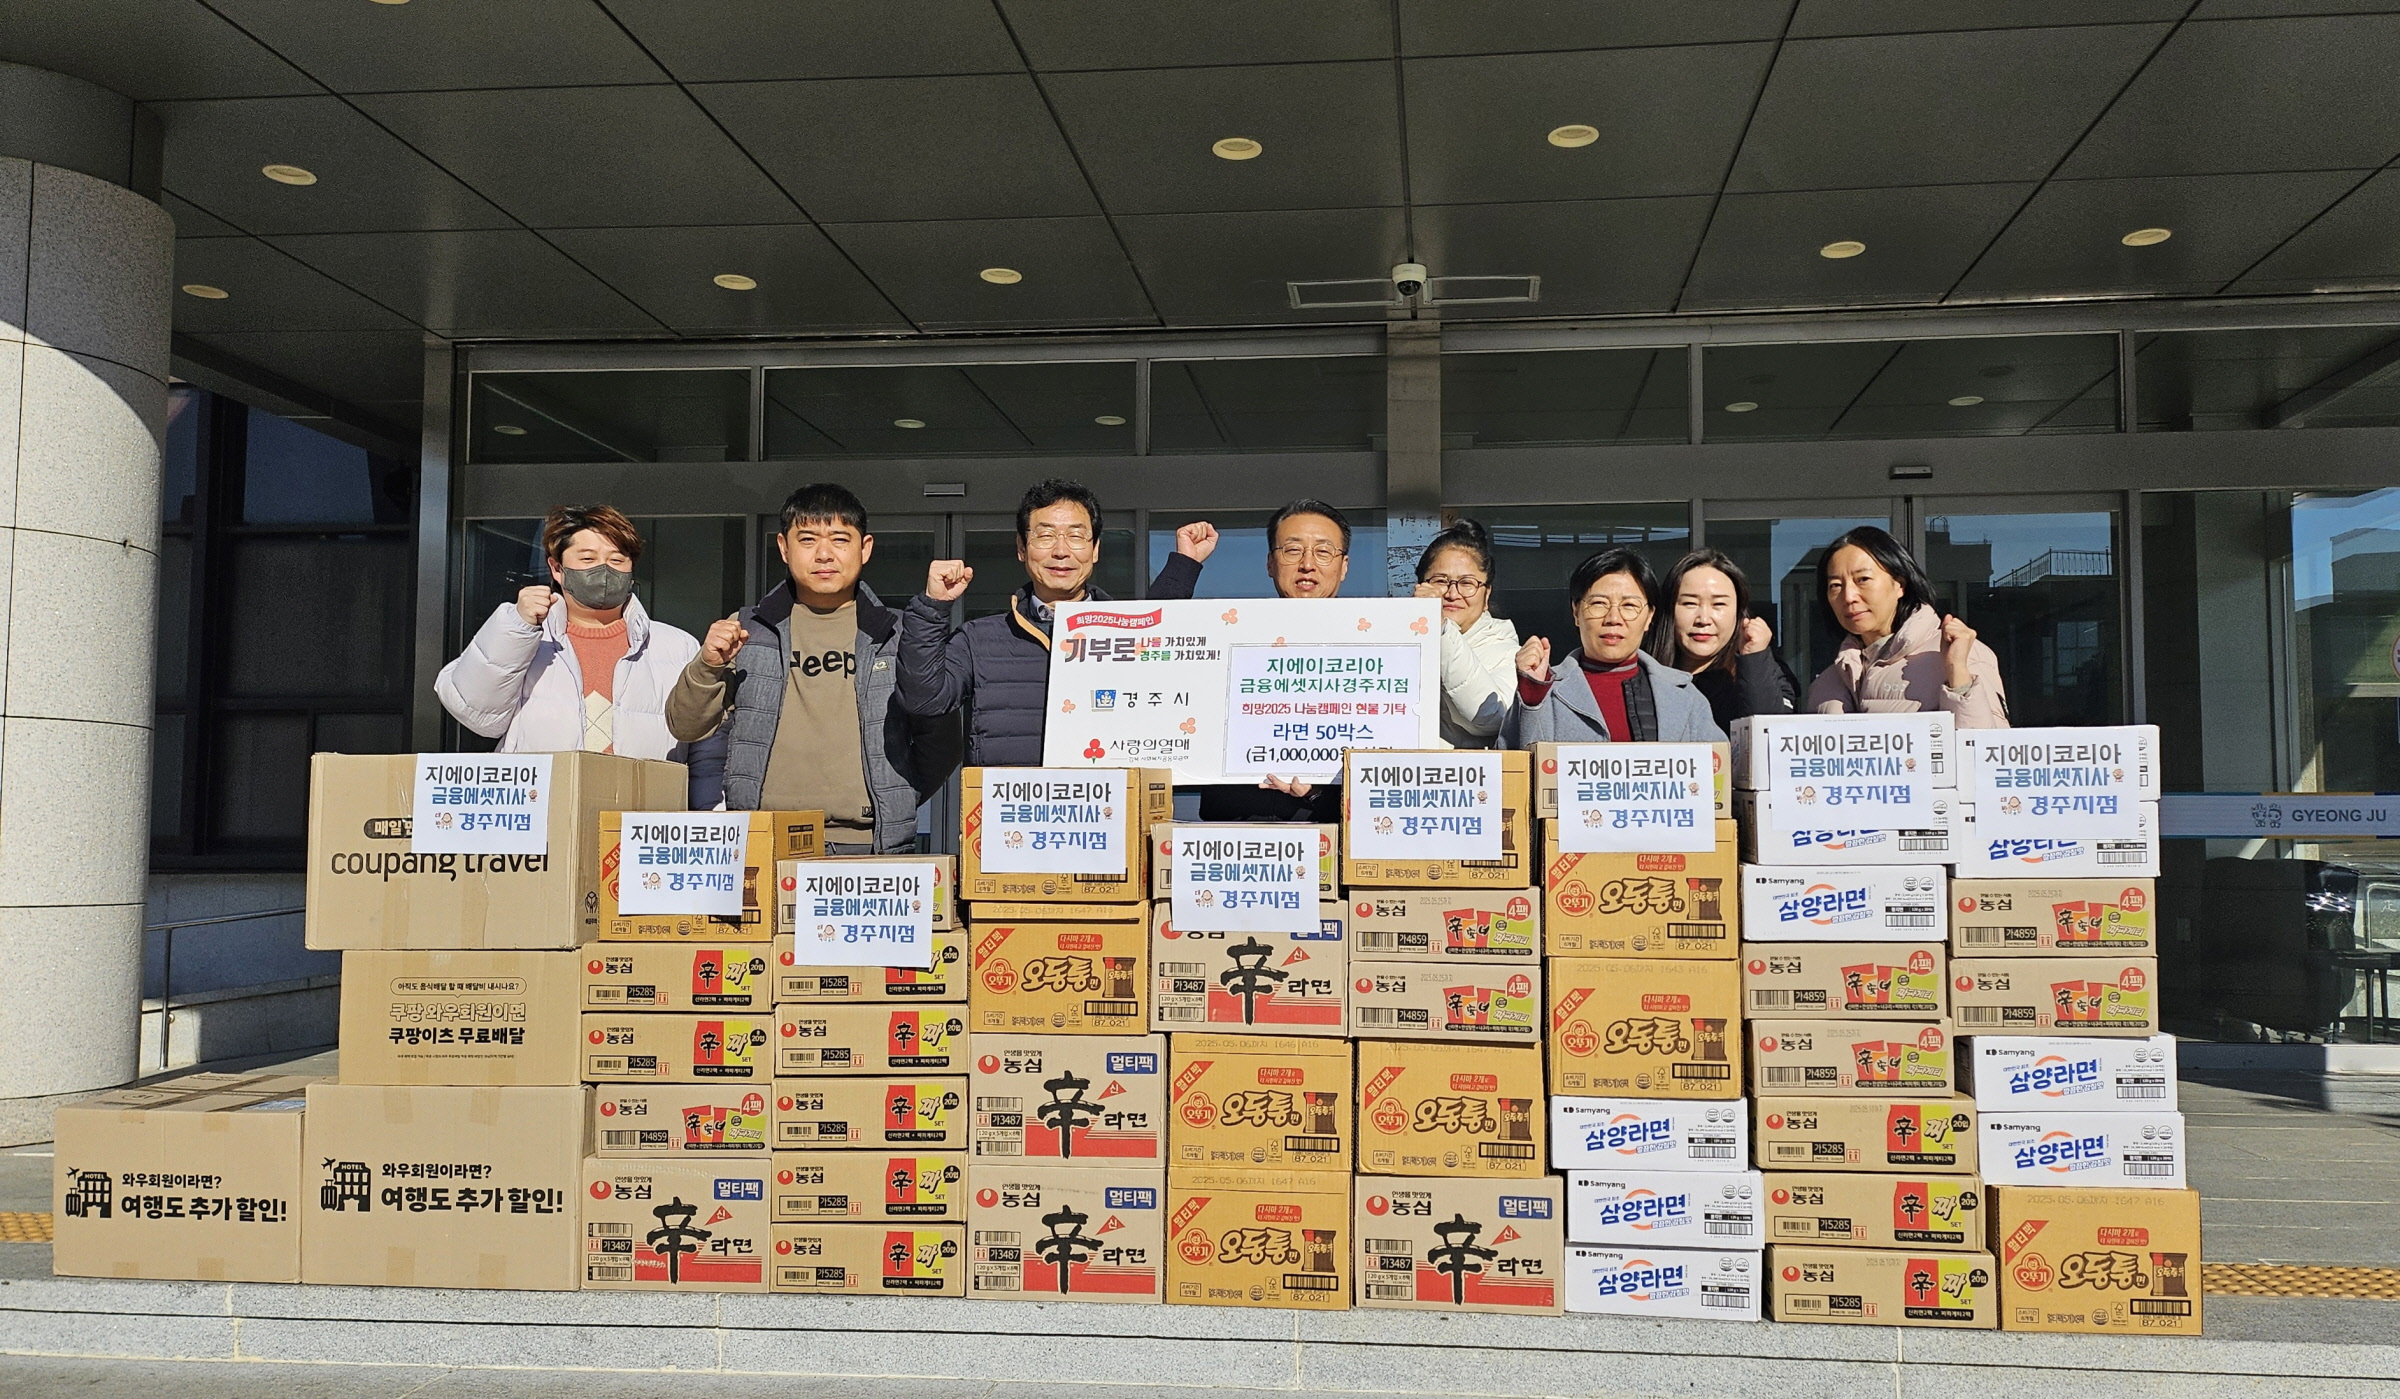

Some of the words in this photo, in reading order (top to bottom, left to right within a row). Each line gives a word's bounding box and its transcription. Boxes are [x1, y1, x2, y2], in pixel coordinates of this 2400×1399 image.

[1076, 615, 1154, 628] 희망2025나눔캠페인
[1141, 637, 1161, 647] 나를
[1165, 637, 1206, 647] 가치있게
[1065, 638, 1135, 662] 기부로
[1140, 651, 1171, 661] 경주를
[1174, 650, 1220, 661] 가치있게!
[1267, 657, 1383, 674] 지에이코리아
[1240, 678, 1408, 693] 금융에셋지사경주지점
[1242, 703, 1291, 715] 희망2025
[1295, 703, 1352, 715] 나눔캠페인
[1356, 703, 1379, 715] 현물
[1383, 703, 1406, 715] 기탁
[1273, 723, 1309, 741] 라면
[1316, 723, 1374, 741] 50박스
[1110, 738, 1190, 755] 사랑의열매
[1780, 734, 1913, 755] 지에이코리아
[1985, 744, 2121, 766] 지에이코리아
[425, 765, 537, 785] 지에이코리아
[1568, 759, 1696, 779] 지에이코리아
[1790, 757, 1902, 778] 금융에셋지사
[1360, 767, 1486, 786] 지에이코리아
[1995, 767, 2109, 788] 금융에셋지사
[432, 787, 526, 806] 금융에셋지사
[992, 782, 1111, 802] 지에이코리아
[1369, 789, 1474, 808] 금융에셋지사
[1577, 781, 1686, 801] 금융에셋지사
[1823, 785, 1910, 805] 경주지점
[2028, 796, 2117, 815] 경주지점
[1000, 804, 1100, 823] 금융에셋지사
[1609, 809, 1693, 828] 경주지점
[2292, 810, 2361, 822] GYEONG
[2366, 810, 2386, 821] JU
[459, 813, 531, 831] 경주지점
[1399, 817, 1481, 835] 경주지점
[631, 825, 740, 845] 지에이코리아
[1029, 832, 1107, 850] 경주지점
[638, 846, 732, 865] 금융에셋지사
[1182, 840, 1304, 861] 지에이코리아
[332, 852, 457, 882] coupang
[465, 842, 548, 873] travel
[1190, 863, 1293, 882] 금융에셋지사
[667, 873, 734, 891] 경주지점
[806, 876, 920, 896] 지에이코리아
[1769, 877, 1804, 885] Samyang
[814, 898, 909, 916] 금융에셋지사
[1219, 890, 1300, 909] 경주지점
[1779, 888, 1866, 922] 삼양라면
[1980, 899, 2012, 911] 농심
[1376, 905, 1406, 917] 농심
[841, 925, 914, 943] 경주지점
[1400, 935, 1426, 944] 가4859
[2007, 929, 2036, 938] 가4859
[605, 963, 633, 974] 농심
[1770, 962, 1801, 974] 농심
[822, 978, 847, 987] 가5285
[1175, 981, 1203, 991] 가3487
[1376, 981, 1406, 992] 농심
[1977, 979, 2010, 991] 농심
[629, 987, 654, 996] 가5285
[1796, 992, 1825, 1001] 가4859
[390, 1003, 424, 1022] 쿠팡
[426, 1003, 526, 1022] 와우회원이면
[1400, 1010, 1426, 1020] 가4859
[2005, 1008, 2034, 1018] 가4859
[389, 1028, 454, 1044] 쿠팡이츠
[458, 1028, 525, 1044] 무료배달
[606, 1033, 634, 1044] 농심
[799, 1026, 826, 1037] 농심
[1781, 1039, 1812, 1050] 농심
[630, 1057, 655, 1067] 가5285
[824, 1050, 849, 1059] 가5285
[1004, 1058, 1042, 1073] 농심
[1111, 1056, 1153, 1072] 멀티팩
[1807, 1068, 1836, 1078] 가4859
[2009, 1059, 2097, 1094] 삼양라면
[619, 1104, 647, 1115] 농심
[796, 1099, 823, 1110] 농심
[992, 1115, 1020, 1124] 가3487
[1787, 1118, 1817, 1129] 농심
[820, 1123, 846, 1132] 가5285
[1585, 1118, 1669, 1151] 삼양라면
[2004, 1124, 2040, 1132] Samyang
[641, 1132, 667, 1141] 가4859
[1814, 1144, 1843, 1154] 가5285
[2015, 1135, 2104, 1169] 삼양라면
[382, 1163, 491, 1179] 와우회원이라면?
[796, 1172, 823, 1183] 농심
[122, 1173, 222, 1189] 와우회원이라면?
[1591, 1181, 1625, 1189] Samyang
[615, 1184, 652, 1199] 농심
[718, 1182, 759, 1198] 멀티팩
[381, 1187, 451, 1212] 여행도
[456, 1188, 503, 1213] 추가
[507, 1188, 562, 1213] 할인!
[820, 1197, 846, 1206] 가5285
[1002, 1192, 1040, 1207] 농심
[1110, 1190, 1152, 1206] 멀티팩
[1792, 1193, 1823, 1205] 농심
[122, 1195, 185, 1219] 여행도
[189, 1198, 232, 1220] 추가
[236, 1198, 286, 1222] 할인!
[1392, 1200, 1431, 1216] 농심
[1503, 1199, 1547, 1216] 멀티팩
[1600, 1194, 1685, 1225] 삼양라면
[1820, 1219, 1850, 1230] 가5285
[604, 1241, 631, 1251] 가3487
[794, 1244, 821, 1255] 농심
[991, 1249, 1019, 1259] 가3487
[1381, 1258, 1411, 1268] 가3487
[818, 1268, 843, 1278] 가5285
[1803, 1270, 1834, 1282] 농심
[1598, 1266, 1683, 1296] 삼양라면
[1831, 1297, 1860, 1307] 가5285
